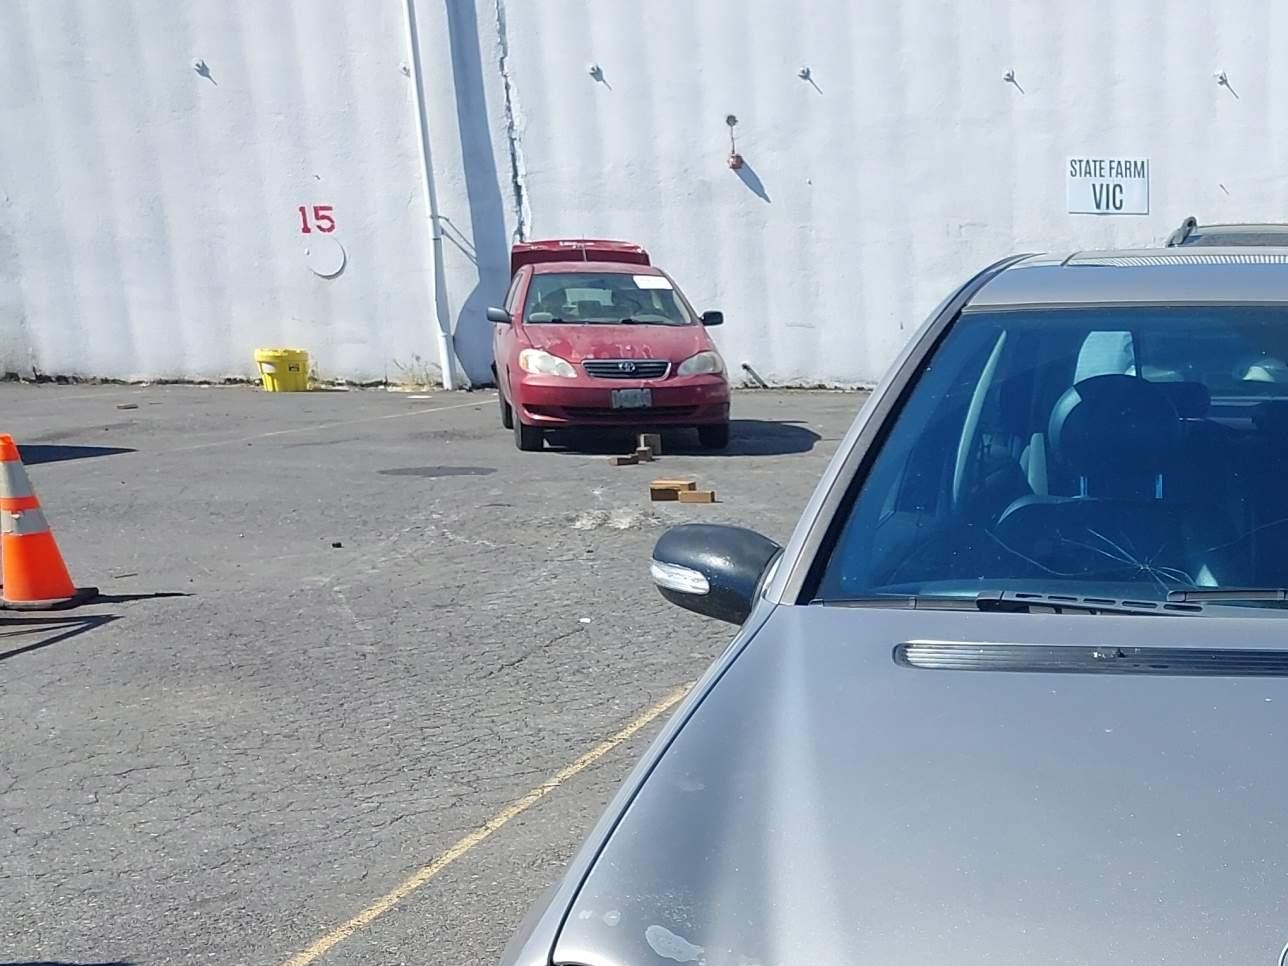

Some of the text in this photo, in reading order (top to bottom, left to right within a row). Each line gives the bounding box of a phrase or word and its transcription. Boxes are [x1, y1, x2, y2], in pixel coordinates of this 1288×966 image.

[1070, 159, 1145, 178] STATE FARM
[1092, 183, 1123, 210] VIC
[299, 206, 335, 233] 15
